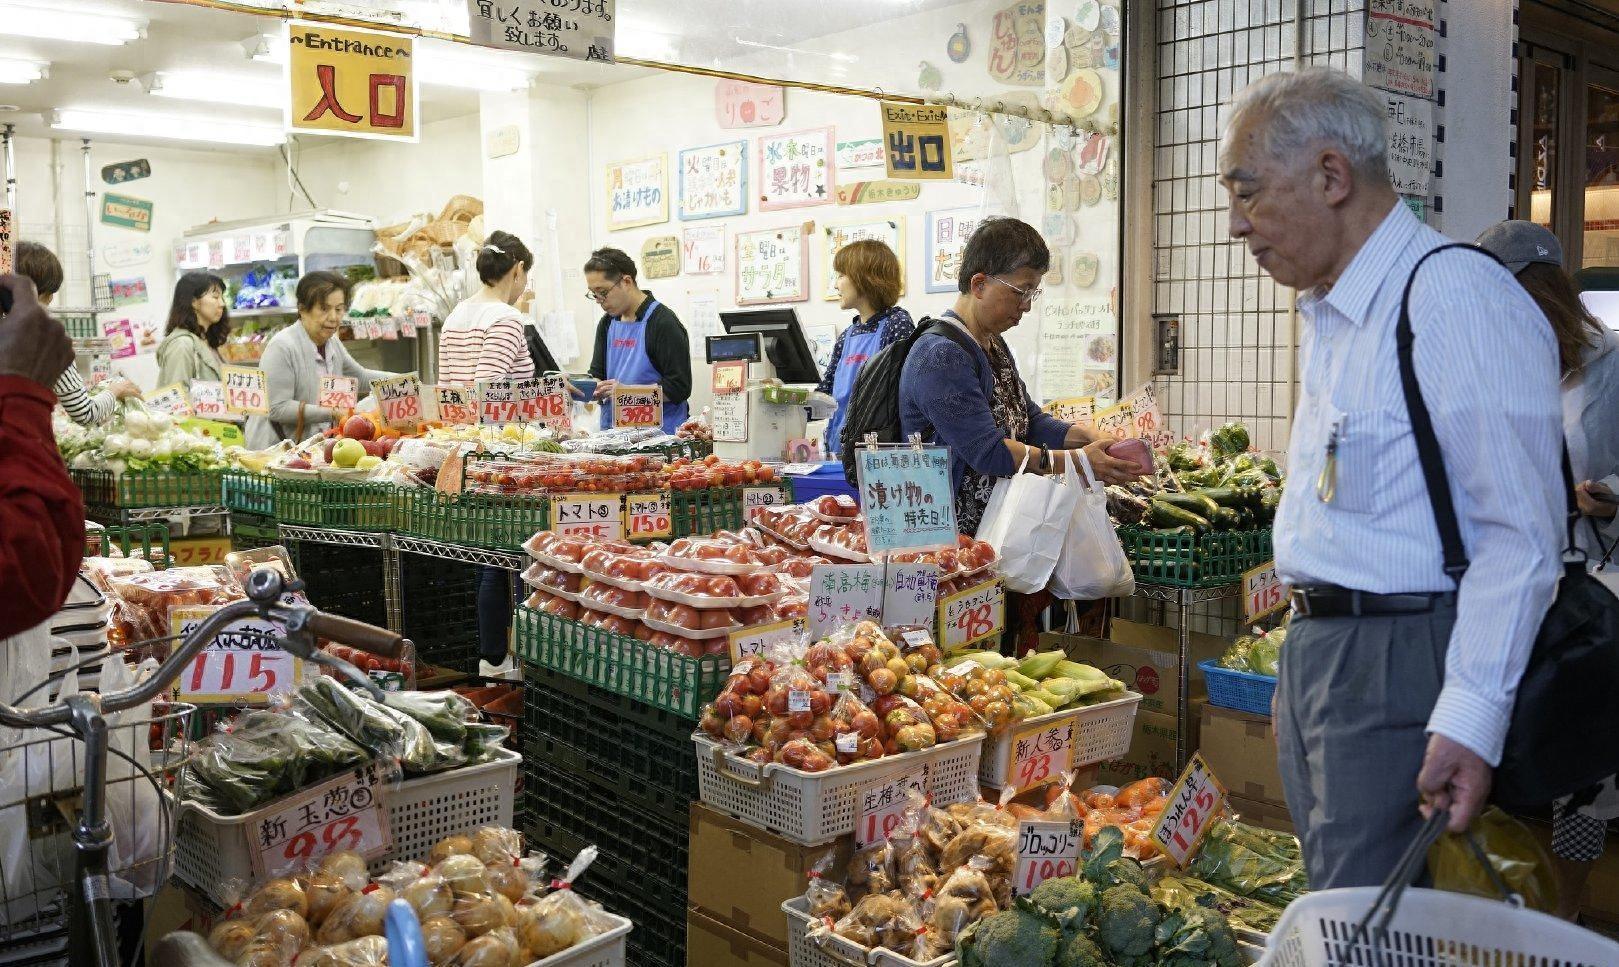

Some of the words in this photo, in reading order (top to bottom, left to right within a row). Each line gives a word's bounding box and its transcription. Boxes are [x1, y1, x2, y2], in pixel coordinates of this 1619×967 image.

[504, 25, 569, 52] 致します。
[302, 64, 406, 128] 入口
[888, 130, 945, 172] 出口
[771, 163, 811, 196] 果物
[226, 372, 254, 388] バナナ
[229, 388, 262, 408] 140
[388, 396, 418, 421] 168
[522, 393, 564, 420] 498
[1056, 403, 1089, 421] ズッキーニ
[1137, 411, 1155, 433] 98
[867, 479, 934, 510] 漬け物の
[632, 515, 669, 533] 150
[1250, 568, 1279, 591] レタス
[1254, 583, 1283, 613] 115
[957, 603, 994, 642] 98
[739, 638, 767, 658] トマト
[190, 652, 283, 692] 115
[1021, 754, 1051, 789] 93
[1157, 773, 1198, 845] ほうれん草
[1172, 785, 1214, 852] 125
[1018, 825, 1075, 856] ブロッコリー
